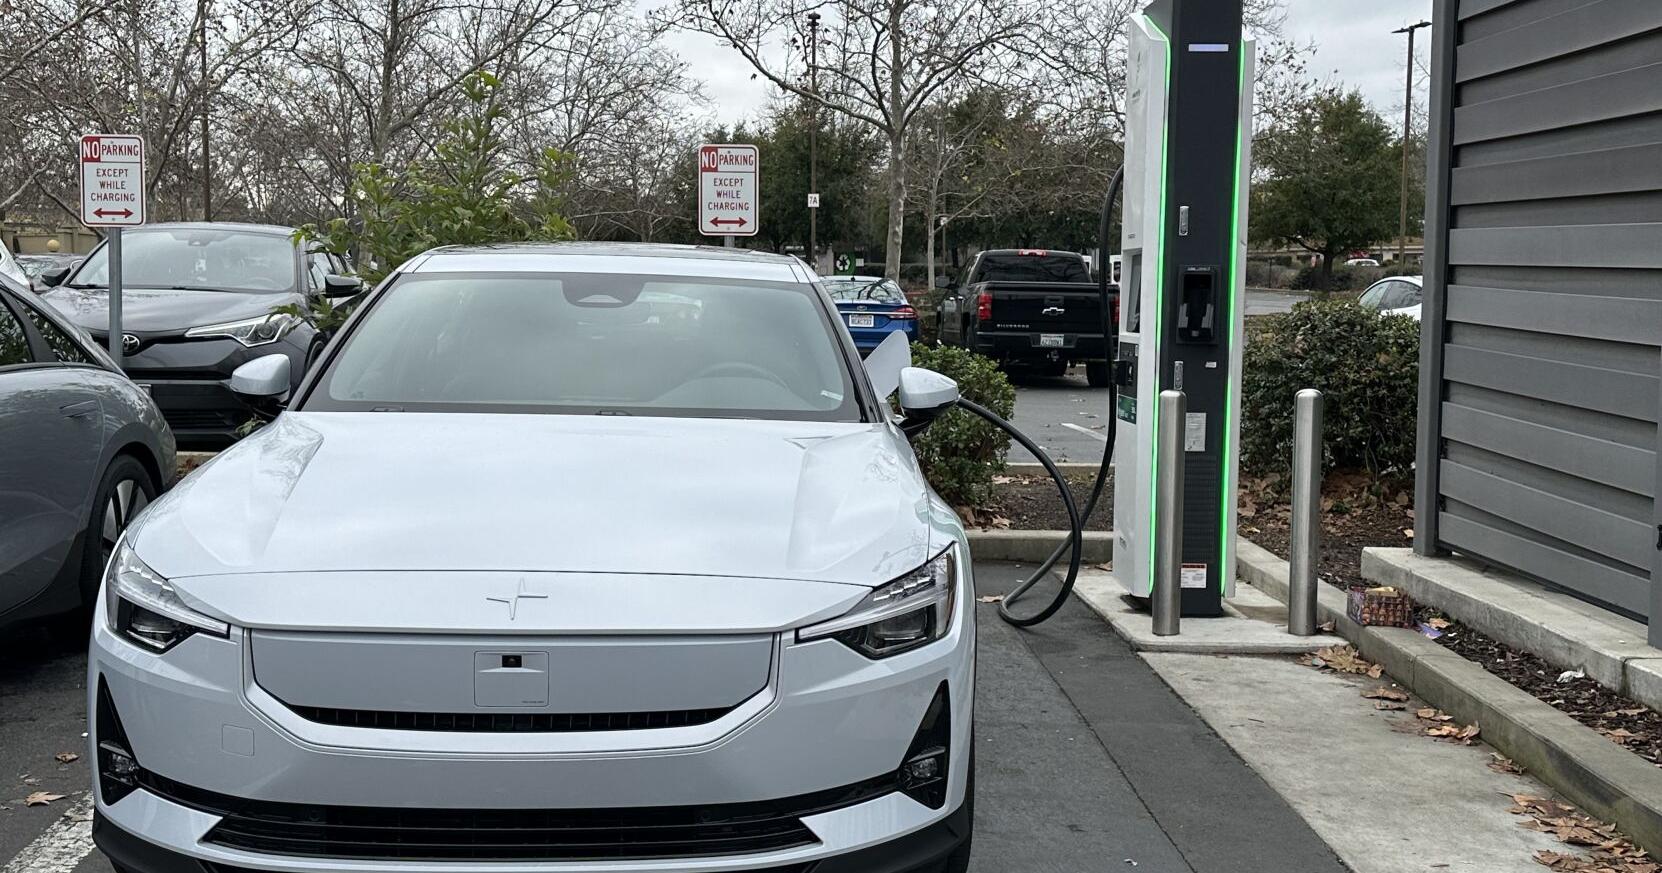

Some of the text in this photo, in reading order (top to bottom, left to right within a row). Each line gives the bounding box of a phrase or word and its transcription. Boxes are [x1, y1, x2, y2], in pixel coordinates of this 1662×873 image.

[83, 141, 139, 158] NO PARKING
[702, 151, 754, 168] NO PARKING
[96, 168, 129, 177] EXCEPT
[99, 181, 127, 189] WHILE
[713, 178, 744, 187] EXCEPT
[90, 192, 136, 202] CHARGING
[716, 190, 741, 199] WHILE
[707, 202, 750, 211] CHARGING
